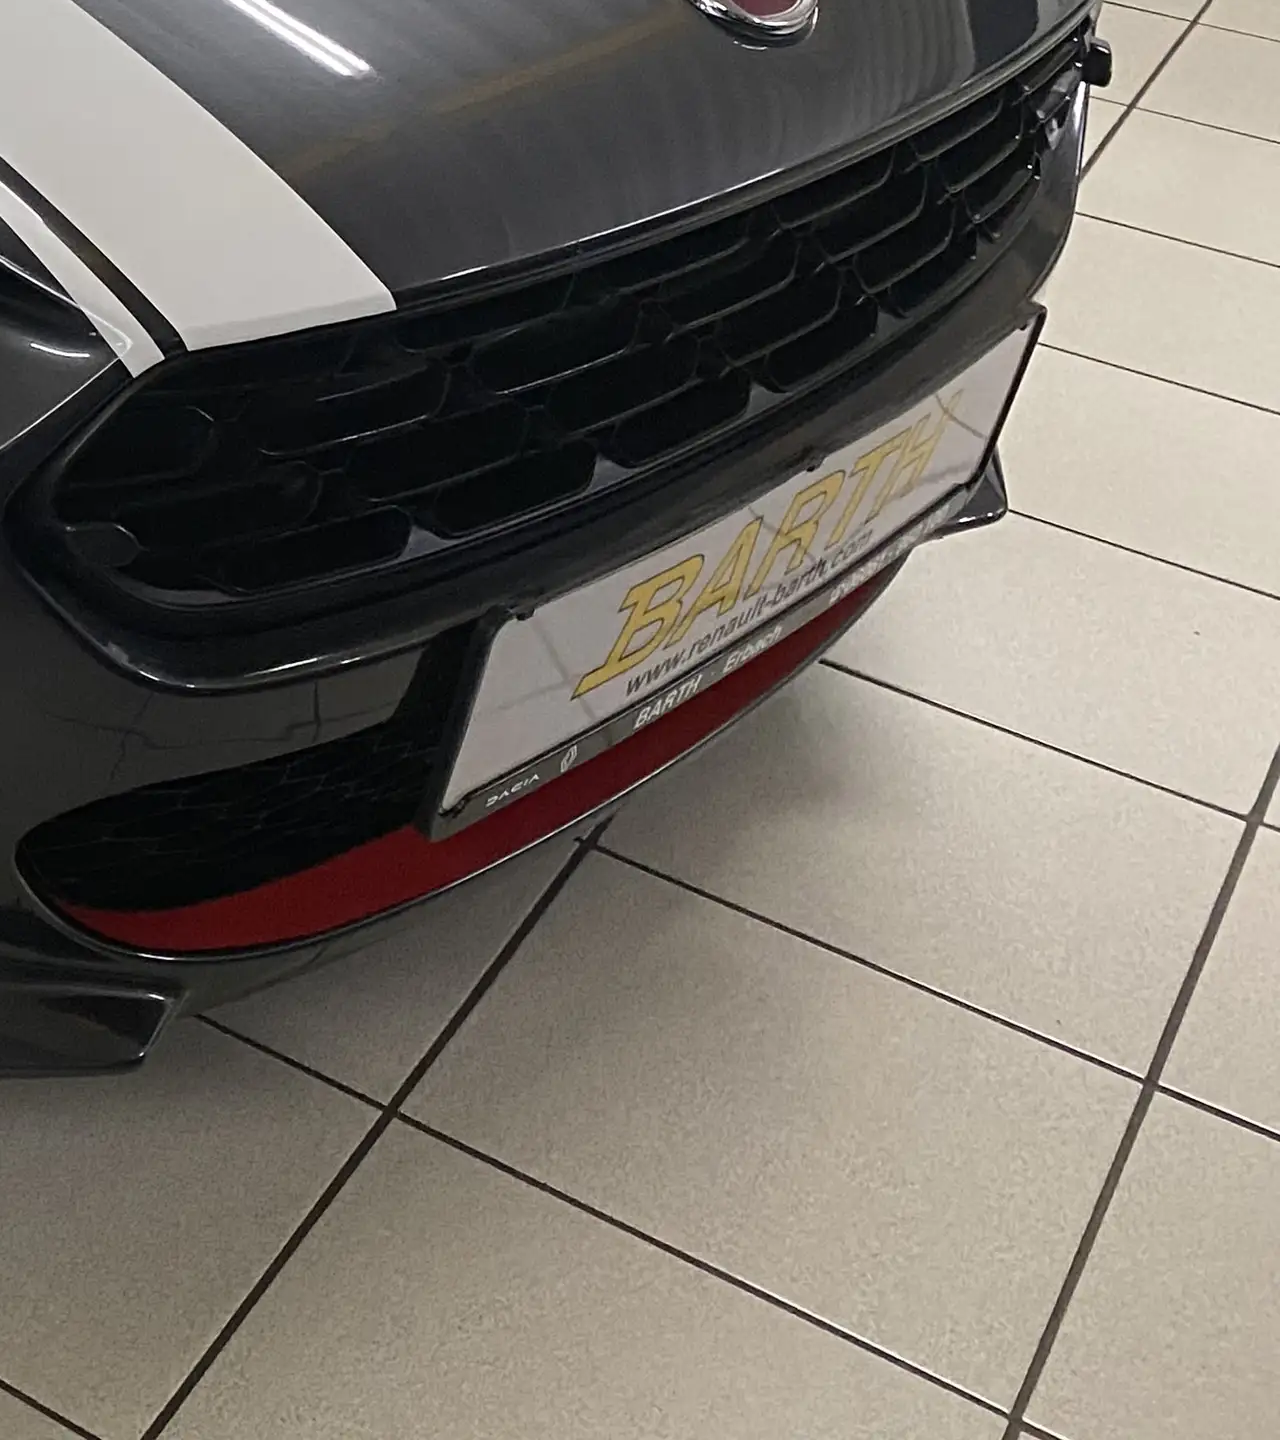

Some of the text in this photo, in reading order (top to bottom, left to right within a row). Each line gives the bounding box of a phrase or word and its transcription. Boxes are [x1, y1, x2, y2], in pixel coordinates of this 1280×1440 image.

[570, 389, 966, 701] BARTH
[624, 528, 875, 698] www.renault-barth.com
[485, 773, 540, 809] DACIA
[633, 673, 704, 731] BARTH
